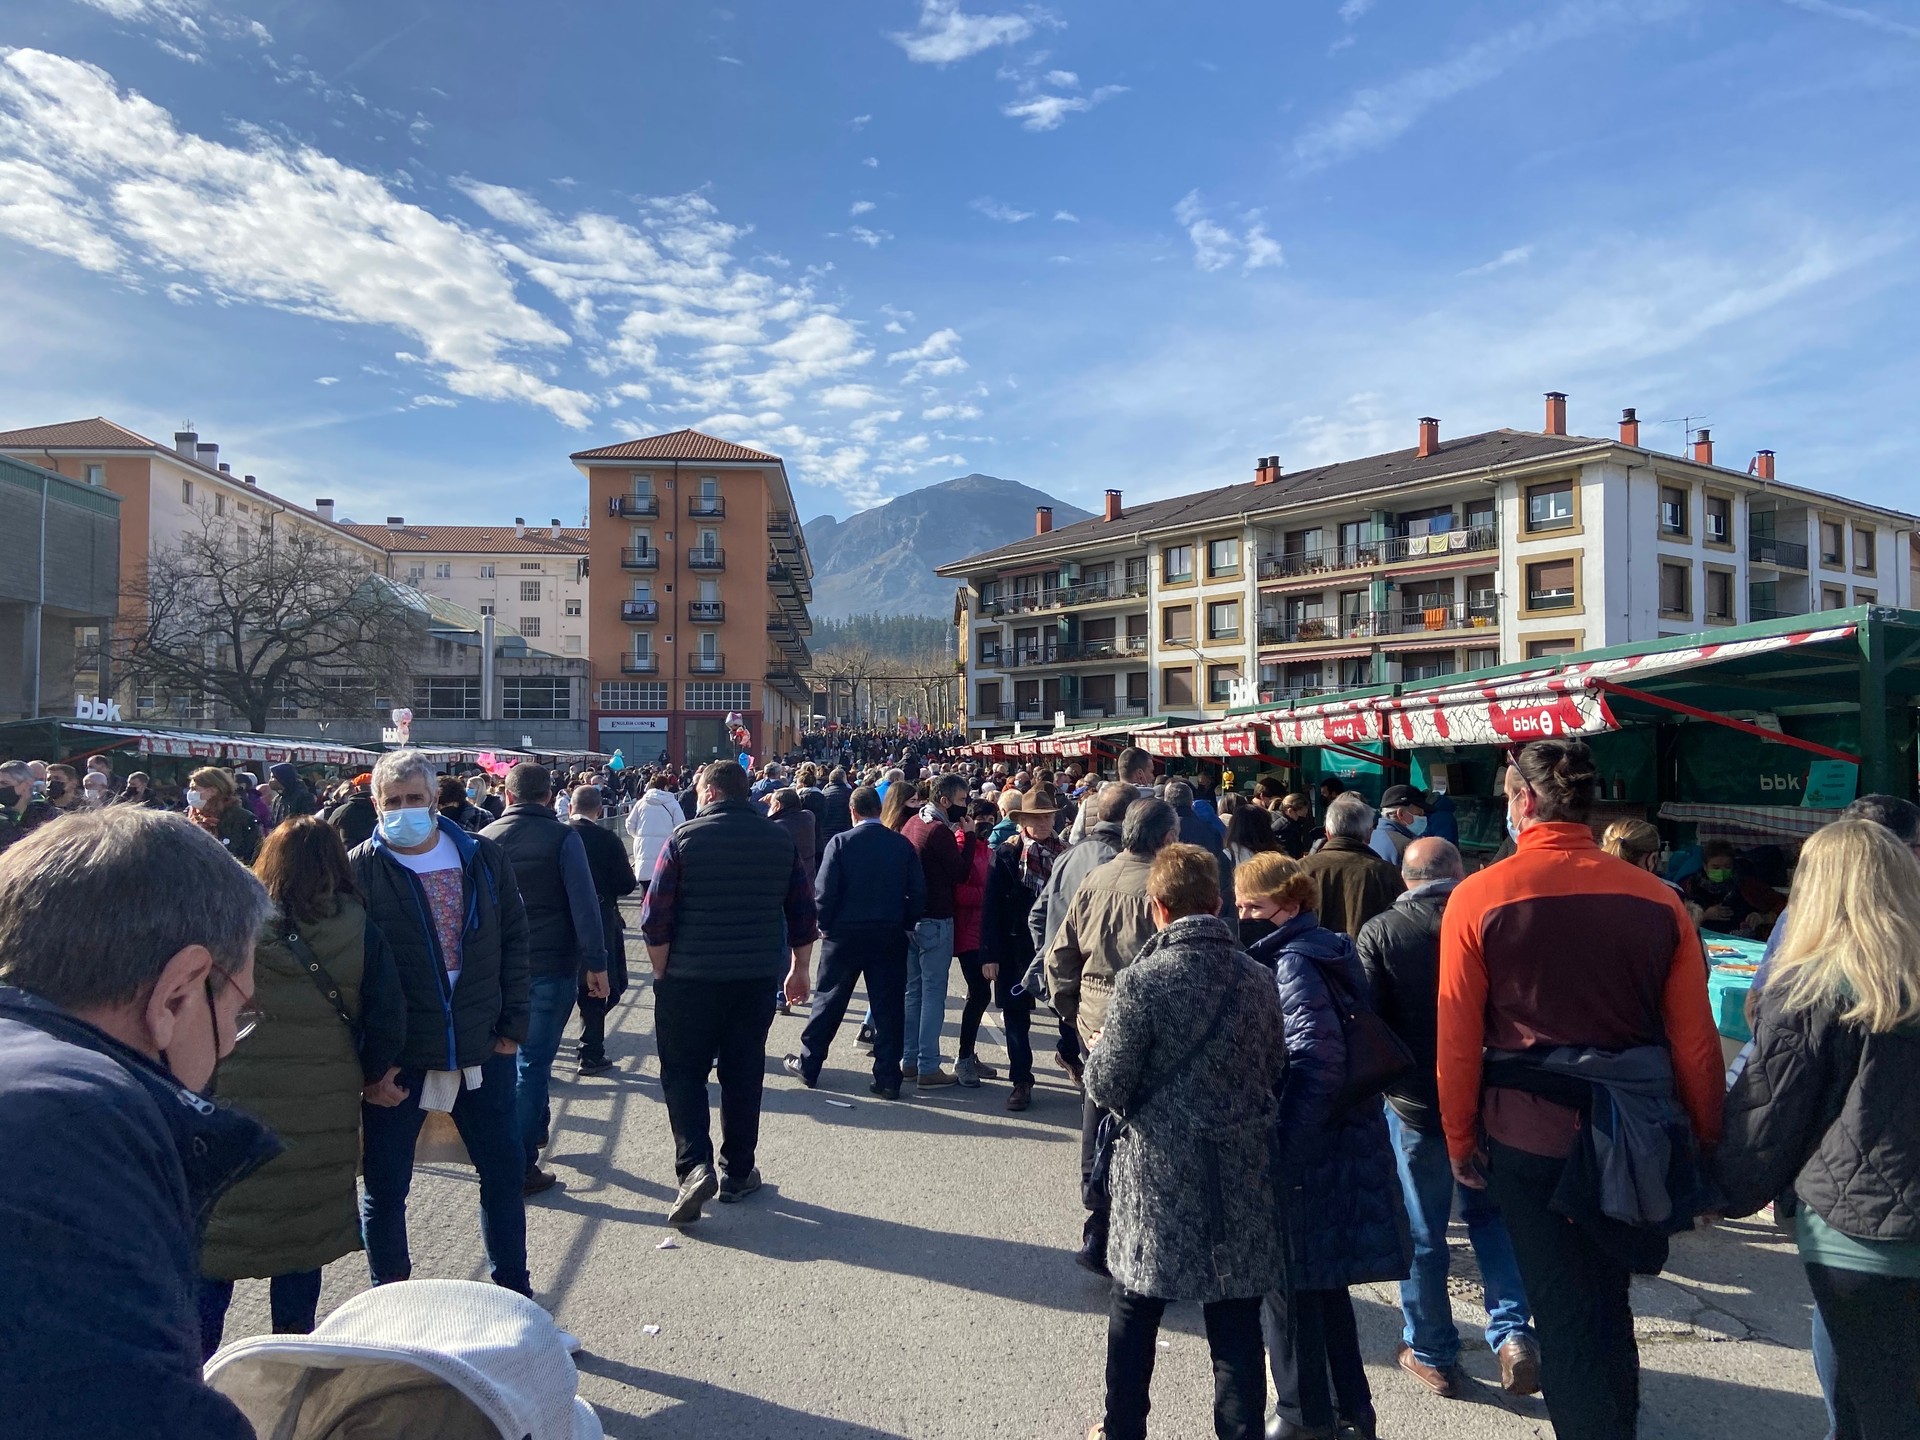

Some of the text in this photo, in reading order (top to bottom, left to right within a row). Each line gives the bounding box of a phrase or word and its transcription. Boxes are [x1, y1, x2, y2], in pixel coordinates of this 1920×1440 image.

[1230, 674, 1260, 709] bbk
[76, 694, 122, 722] bbk
[1333, 725, 1347, 738] bbk
[1512, 715, 1539, 732] bbk
[1760, 773, 1800, 791] bbk
